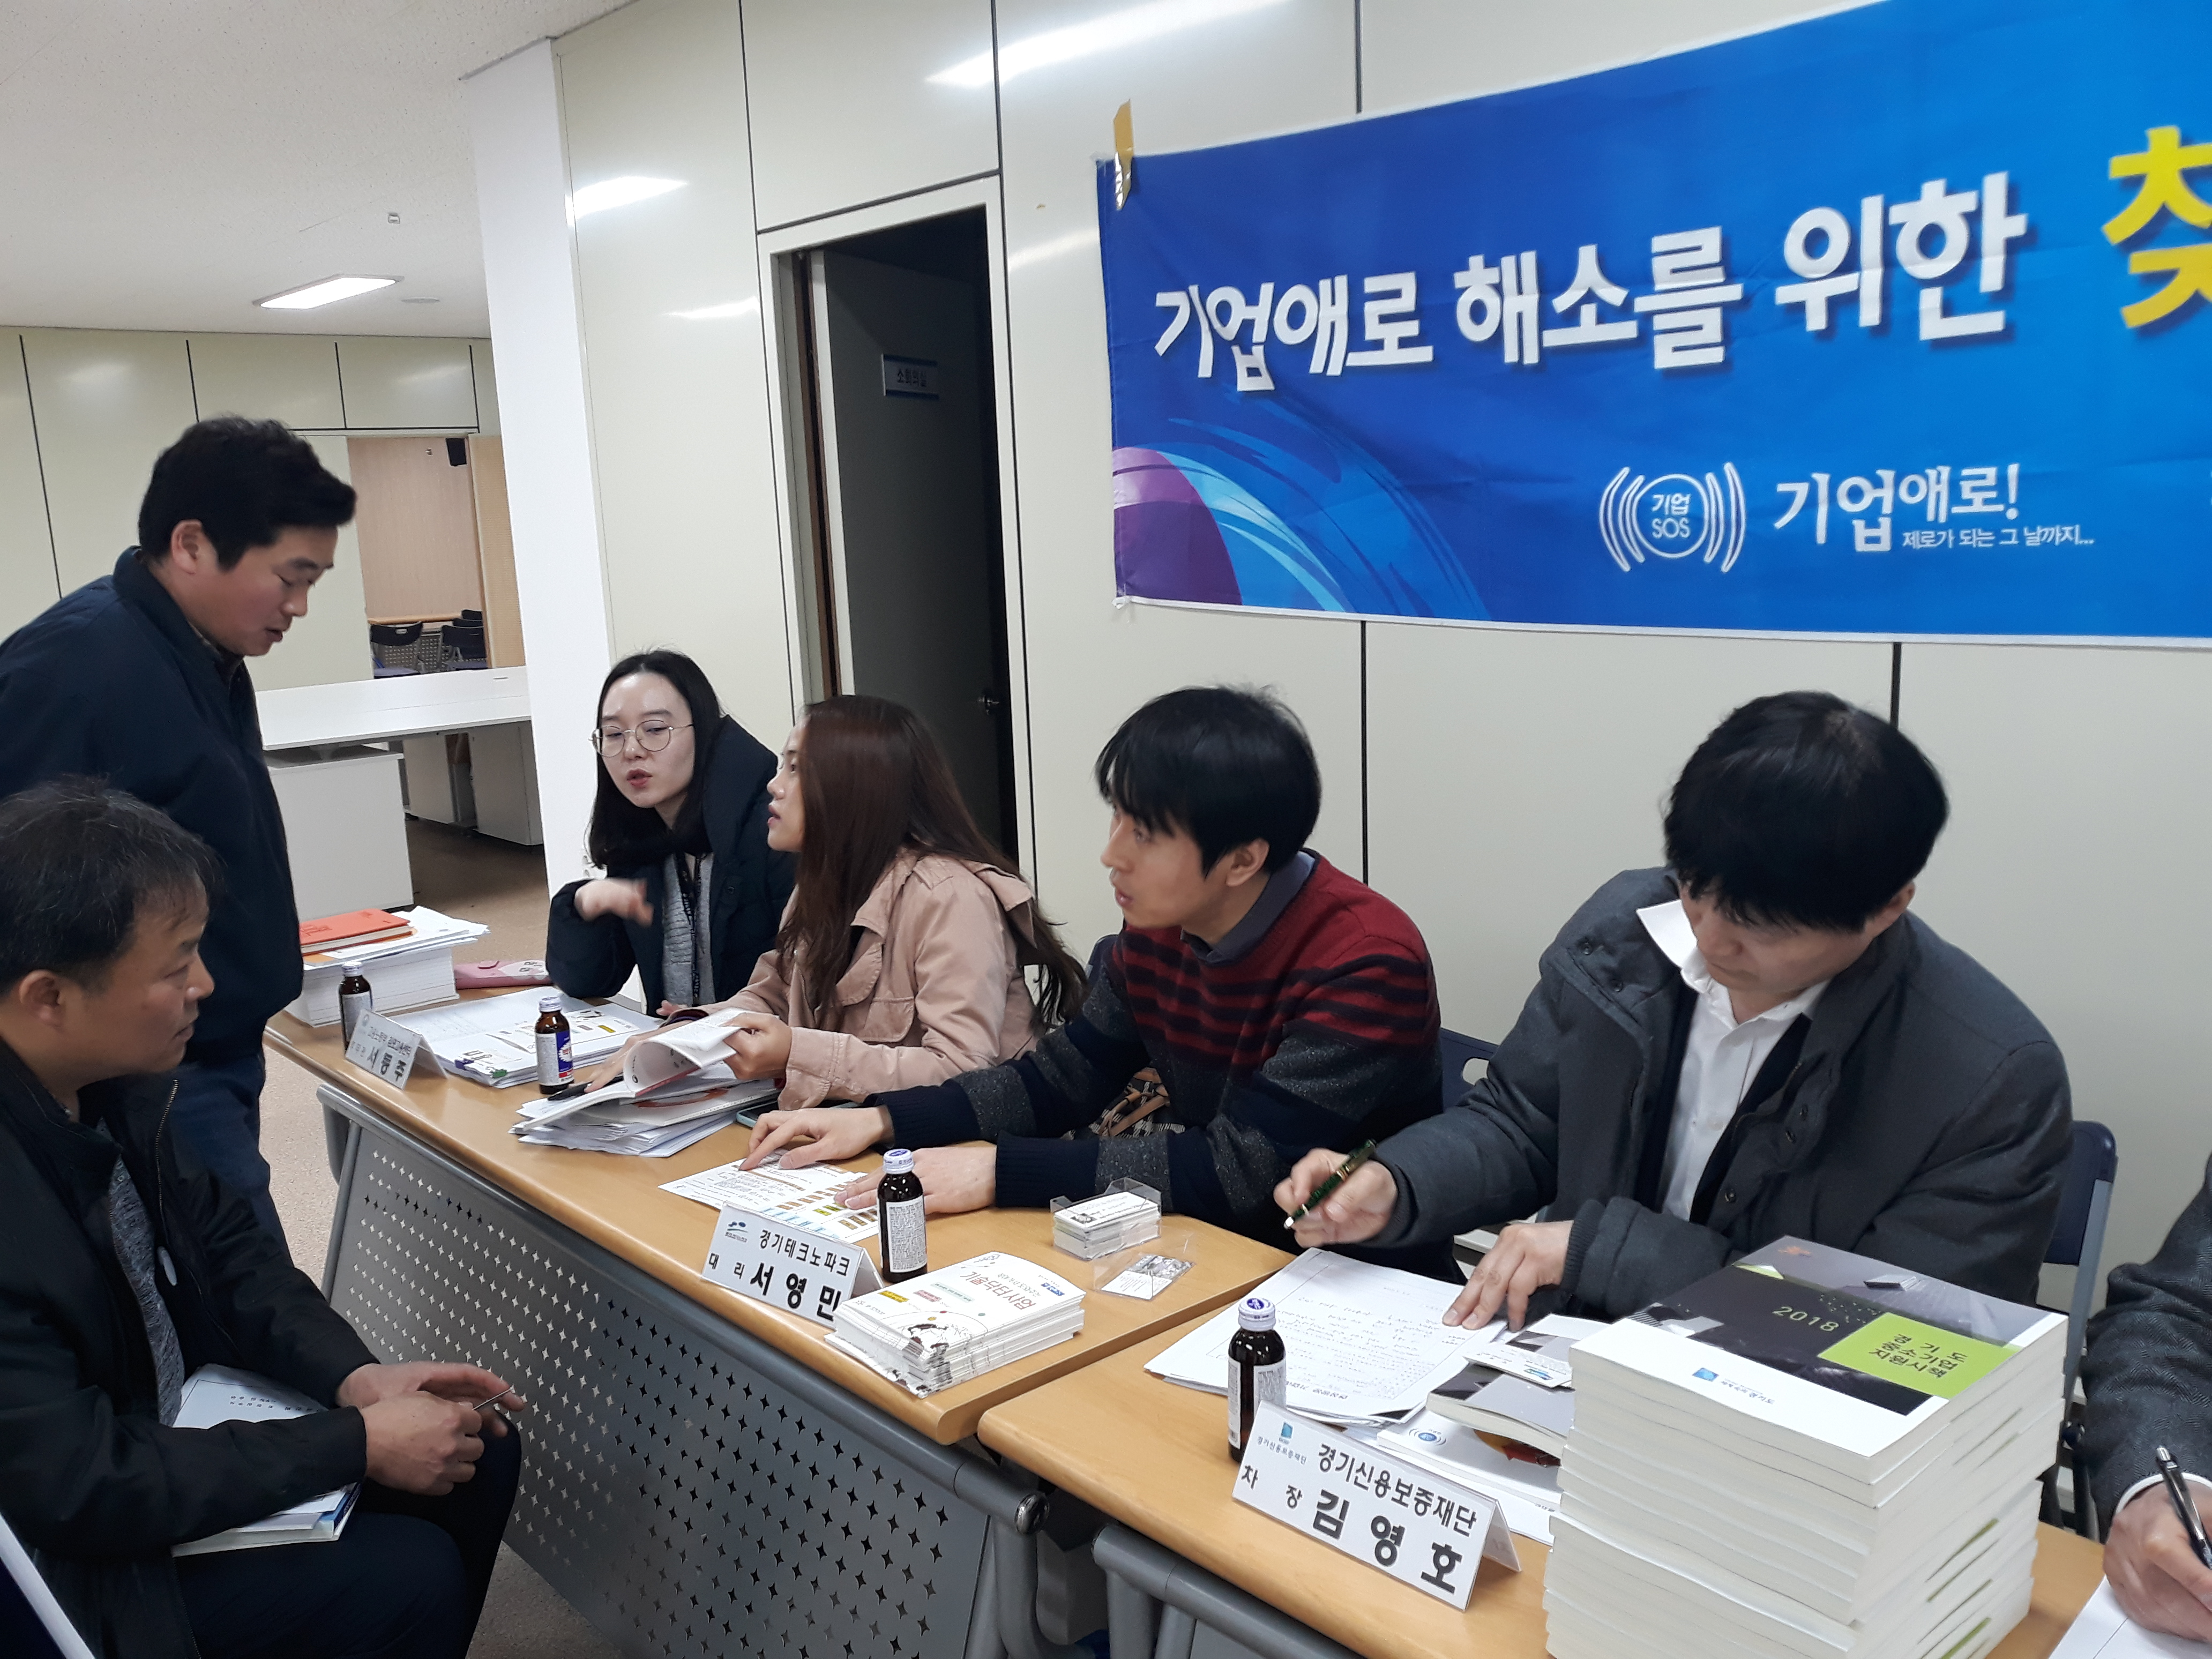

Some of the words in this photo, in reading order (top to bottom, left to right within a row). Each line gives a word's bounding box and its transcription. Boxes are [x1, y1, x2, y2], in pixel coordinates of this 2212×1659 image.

[1154, 272, 1434, 392] 기업애로
[1454, 226, 1743, 370] 해소를
[1775, 172, 2027, 341] 위한
[1651, 494, 1691, 515] 기업
[1774, 462, 2020, 552] 기업애로!
[1651, 517, 1690, 539] SOS
[1902, 529, 1955, 549] 제로가
[1959, 528, 1995, 548] 되는
[1999, 528, 2019, 545] 그
[760, 1229, 850, 1276] 경기테크노파크
[1772, 1306, 1840, 1332] 2018
[1868, 1348, 1948, 1379] 지원시책
[1881, 1341, 1959, 1371] 중소기업
[1318, 1444, 1477, 1537] 경기신용보증재단
